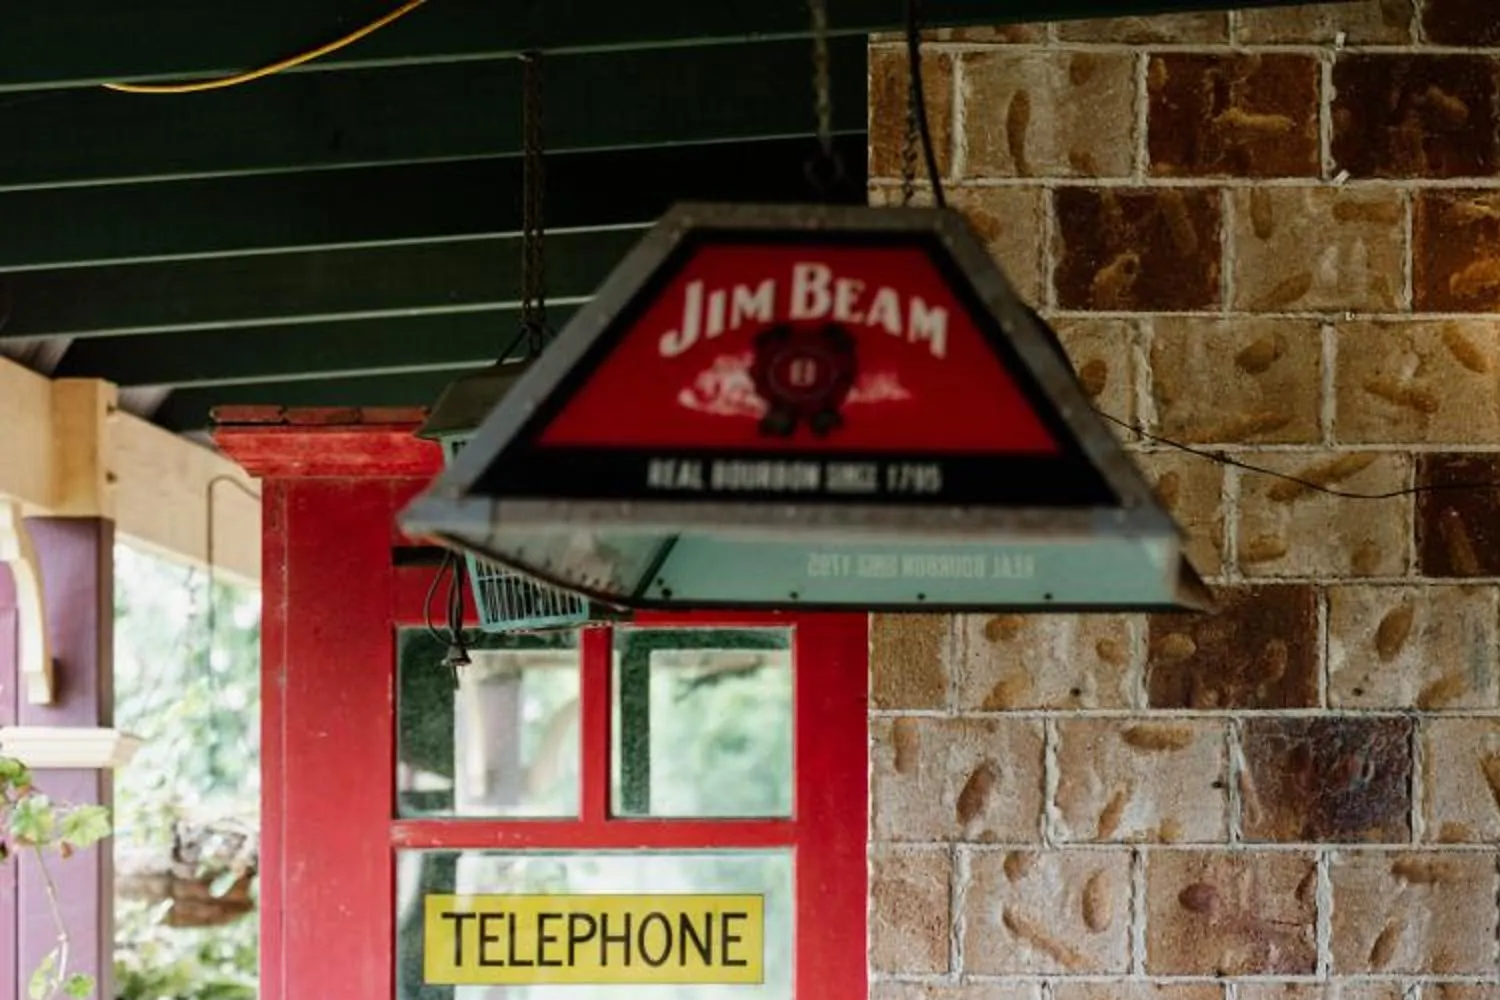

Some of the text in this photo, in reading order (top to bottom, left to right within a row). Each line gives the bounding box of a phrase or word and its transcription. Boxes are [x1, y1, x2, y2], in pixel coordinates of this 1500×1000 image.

[659, 261, 948, 359] JIM BEAM
[648, 459, 702, 489] REAL
[711, 460, 819, 491] BOURBON
[441, 912, 748, 967] TELEPHONE
